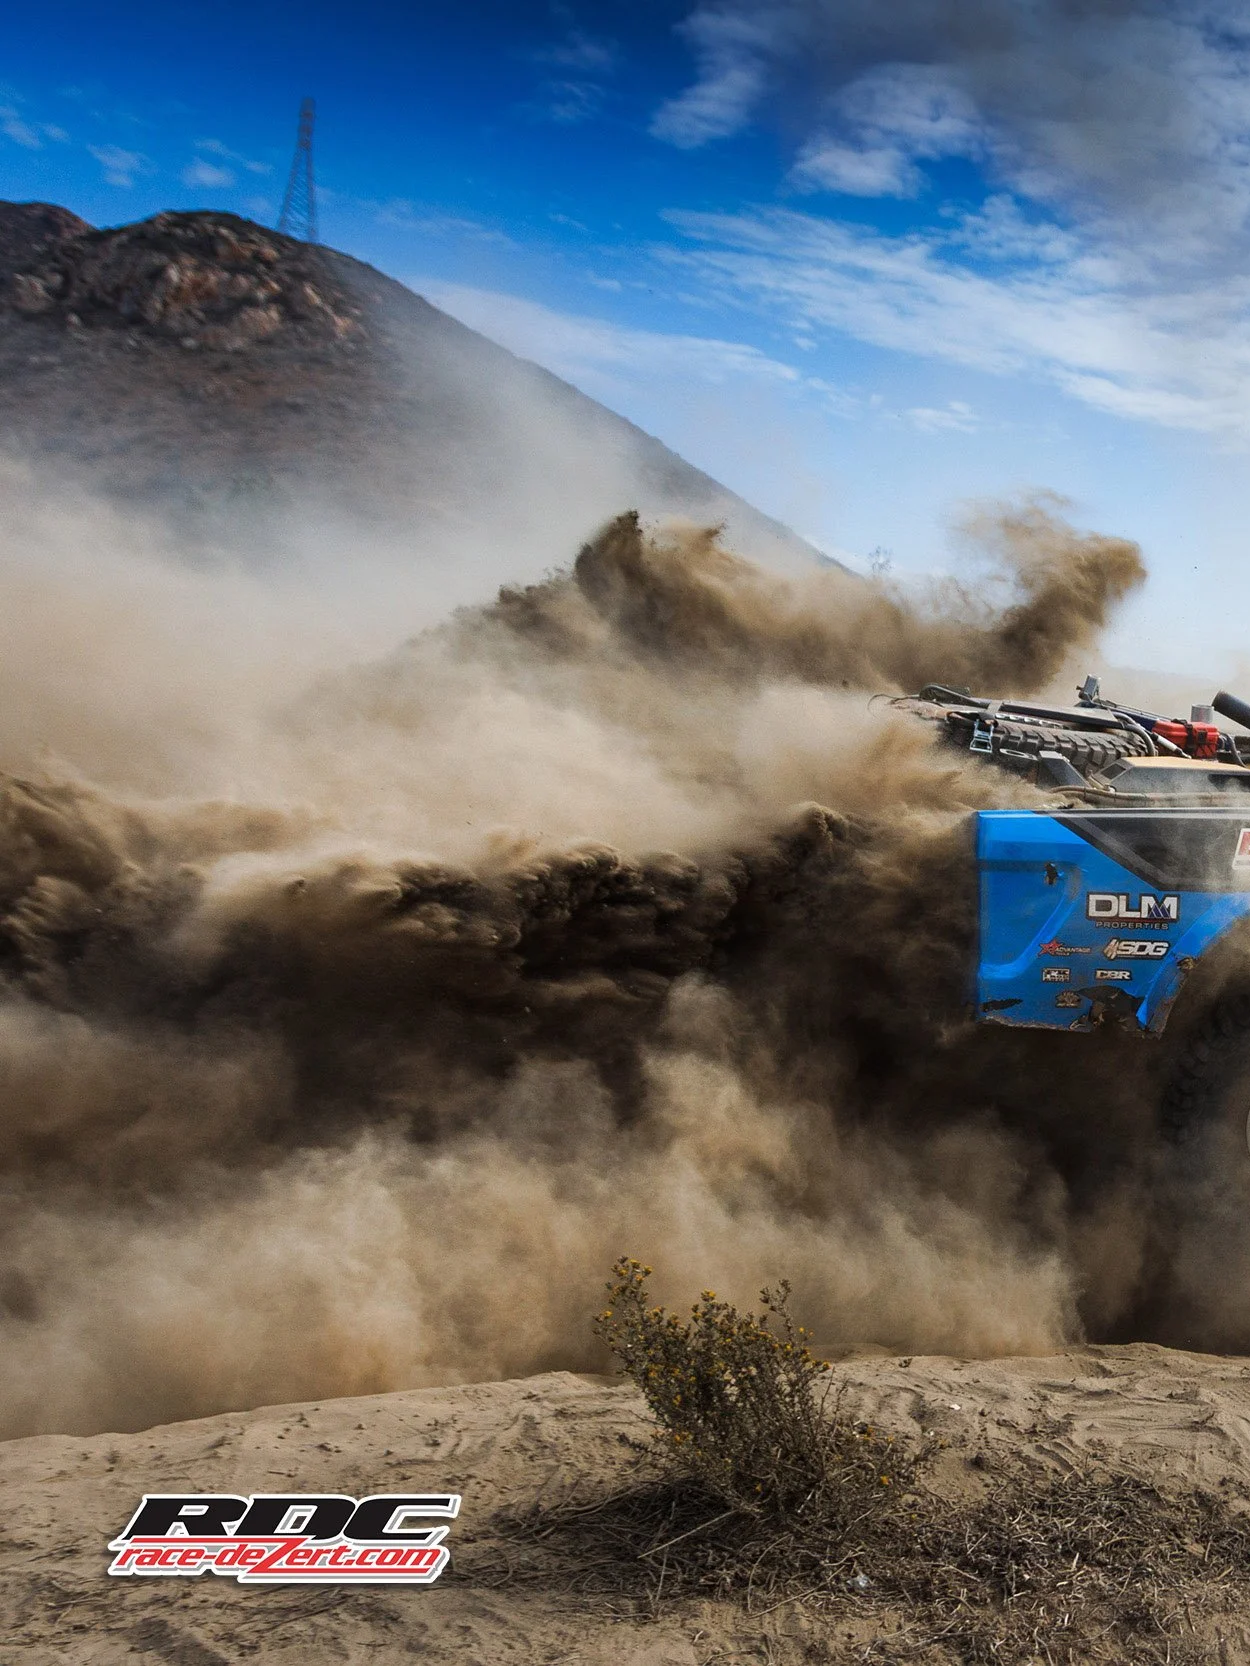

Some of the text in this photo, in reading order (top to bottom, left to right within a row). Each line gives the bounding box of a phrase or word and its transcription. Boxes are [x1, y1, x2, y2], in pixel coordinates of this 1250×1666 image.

[1088, 894, 1178, 919] DLM
[1096, 921, 1169, 931] PROPERTIES
[1117, 941, 1169, 956] SDG
